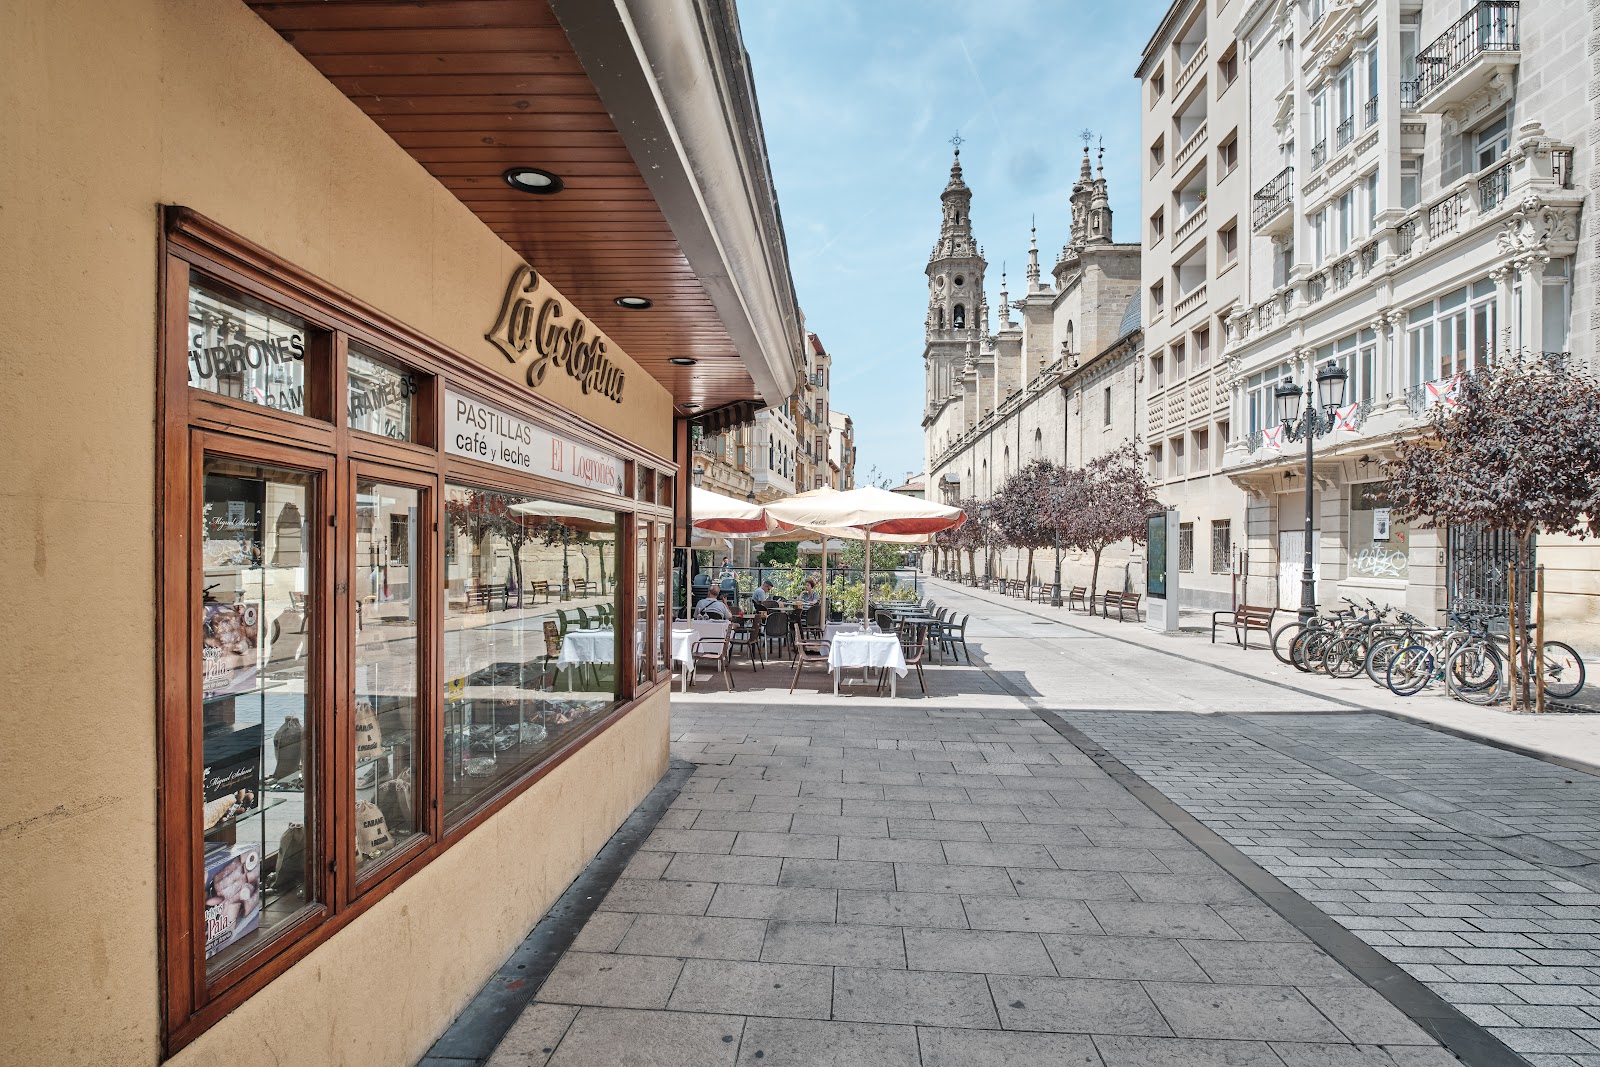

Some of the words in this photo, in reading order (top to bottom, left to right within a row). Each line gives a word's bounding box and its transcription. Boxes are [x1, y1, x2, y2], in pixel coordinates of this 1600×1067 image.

[484, 264, 539, 363] La
[456, 399, 531, 445] PASTILLAS
[456, 432, 487, 456] café
[491, 448, 497, 461] y
[500, 440, 530, 468] leche
[551, 437, 564, 473] El
[572, 445, 615, 487] Logroñés
[208, 914, 229, 942] Pala
